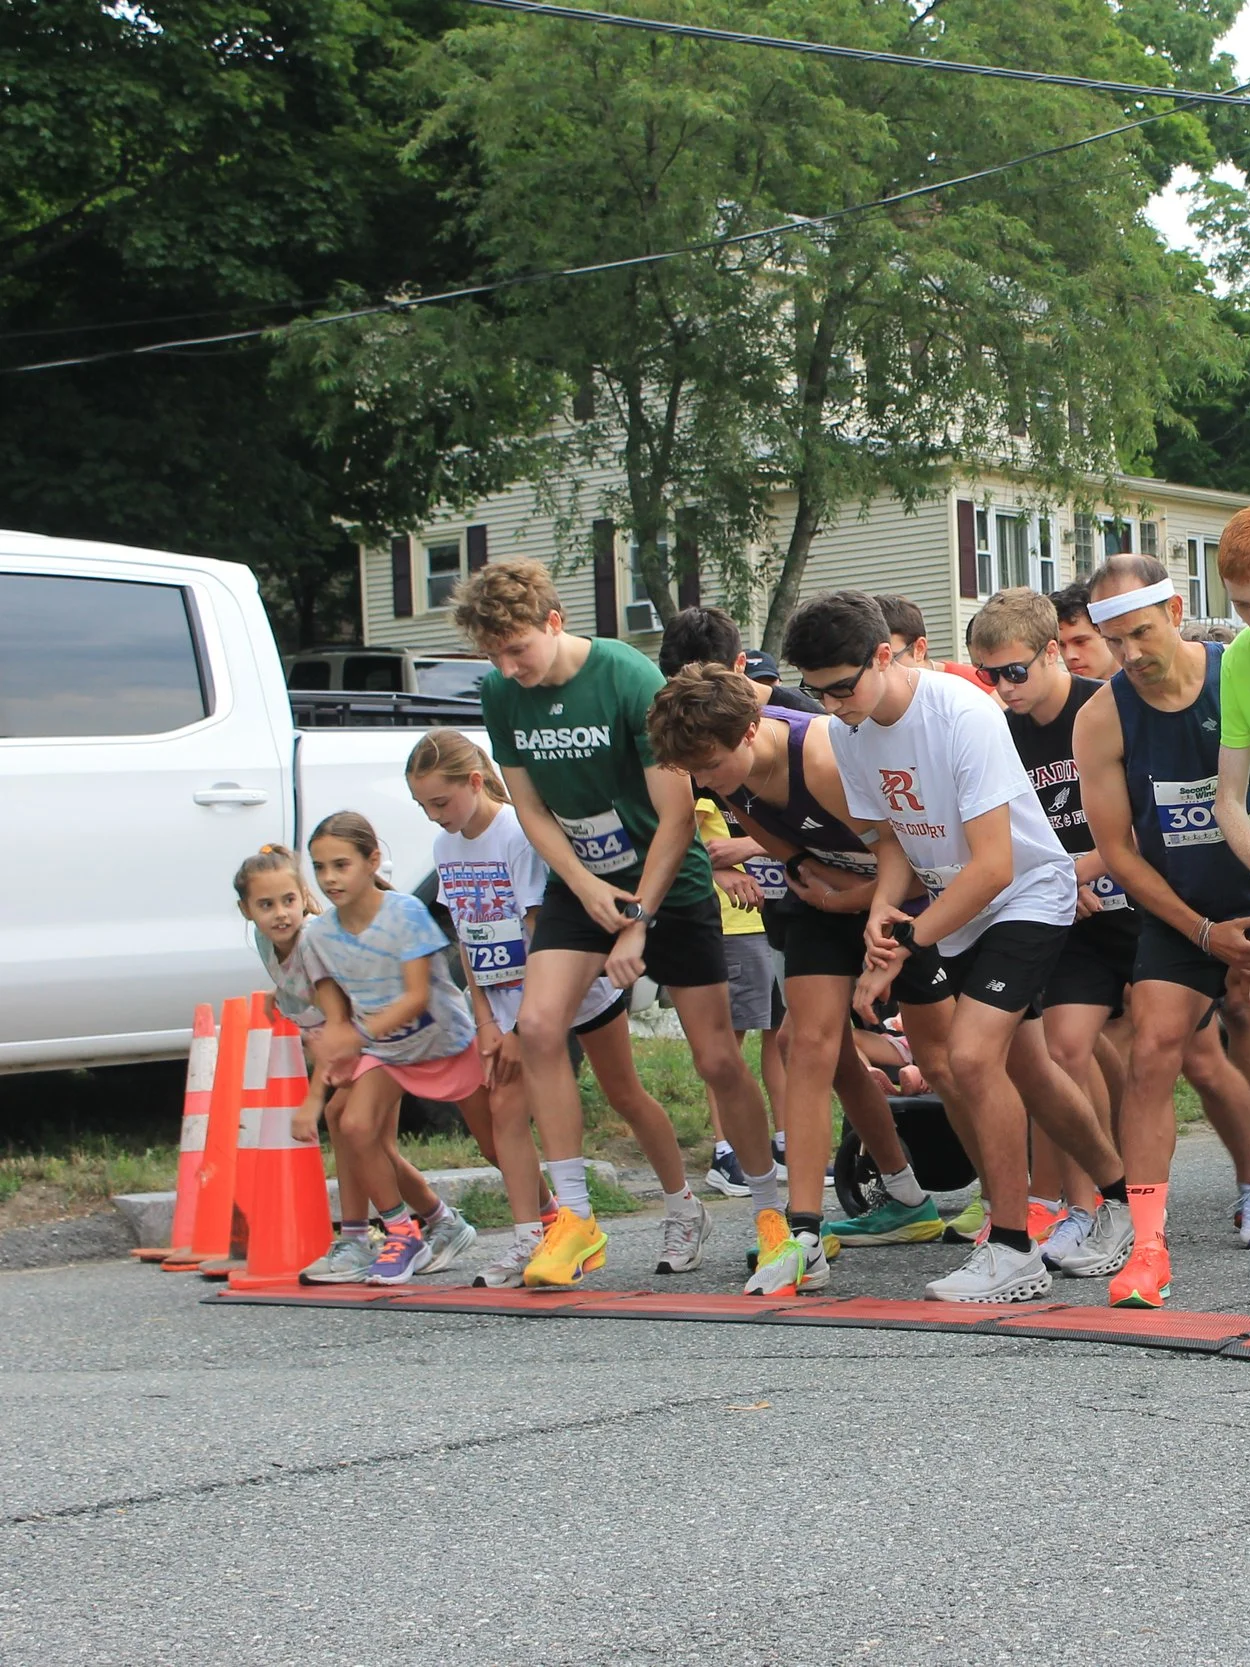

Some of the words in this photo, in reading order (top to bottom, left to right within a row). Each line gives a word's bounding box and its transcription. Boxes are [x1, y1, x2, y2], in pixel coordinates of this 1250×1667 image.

[513, 725, 612, 751] BABSON
[533, 750, 592, 761] BEAVERS
[1179, 783, 1212, 795] Second
[1195, 788, 1217, 800] Wind
